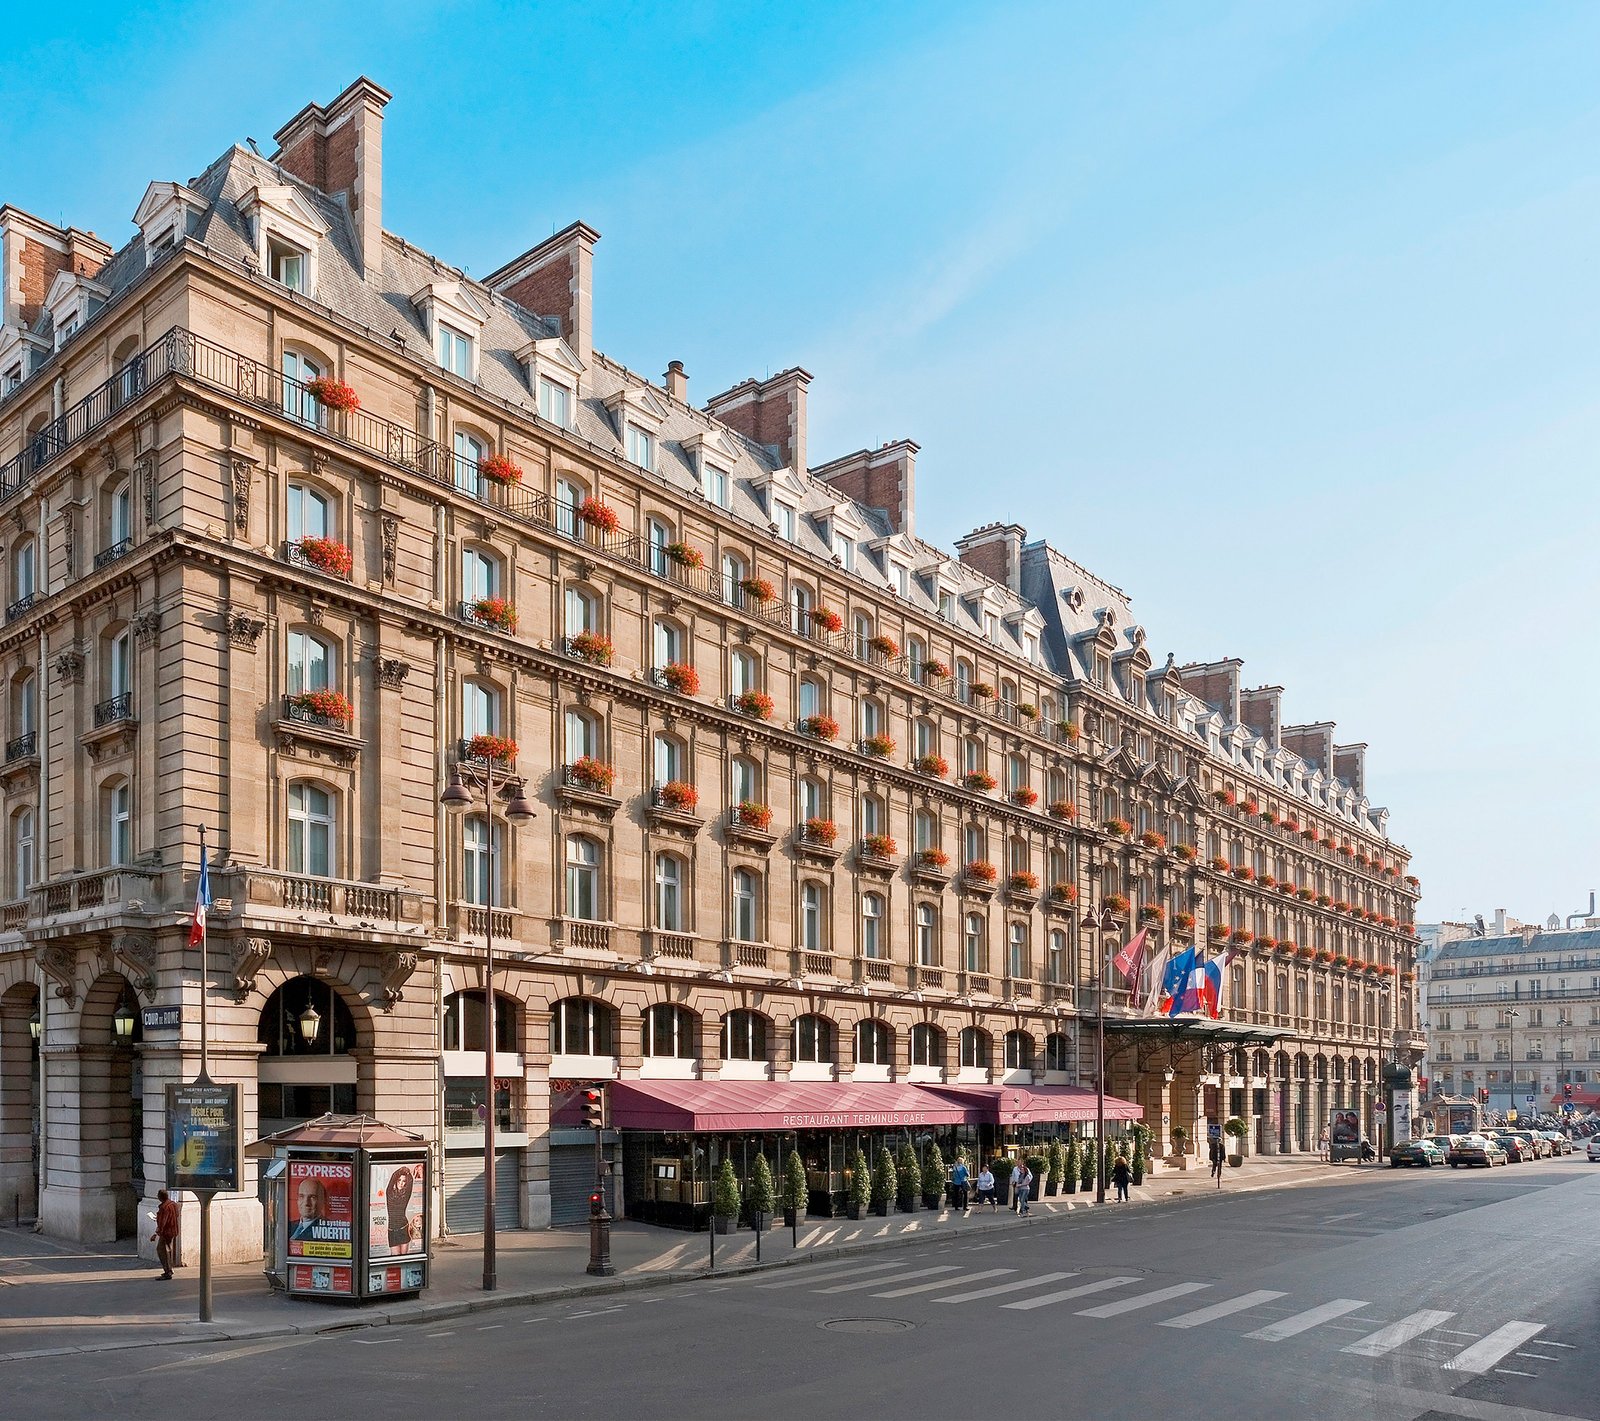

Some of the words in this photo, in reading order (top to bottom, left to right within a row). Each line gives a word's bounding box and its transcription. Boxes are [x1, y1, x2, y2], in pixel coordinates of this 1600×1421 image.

[145, 1012, 158, 1025] COUR
[164, 1011, 179, 1024] ROME
[783, 1114, 849, 1126] RESTAURANT
[853, 1113, 899, 1125] TERMINUS
[1054, 1111, 1067, 1119] BAR
[1070, 1110, 1094, 1119] GOLDEN
[291, 1164, 351, 1178] L'EXPRESS
[312, 1226, 351, 1240] WOERTH
